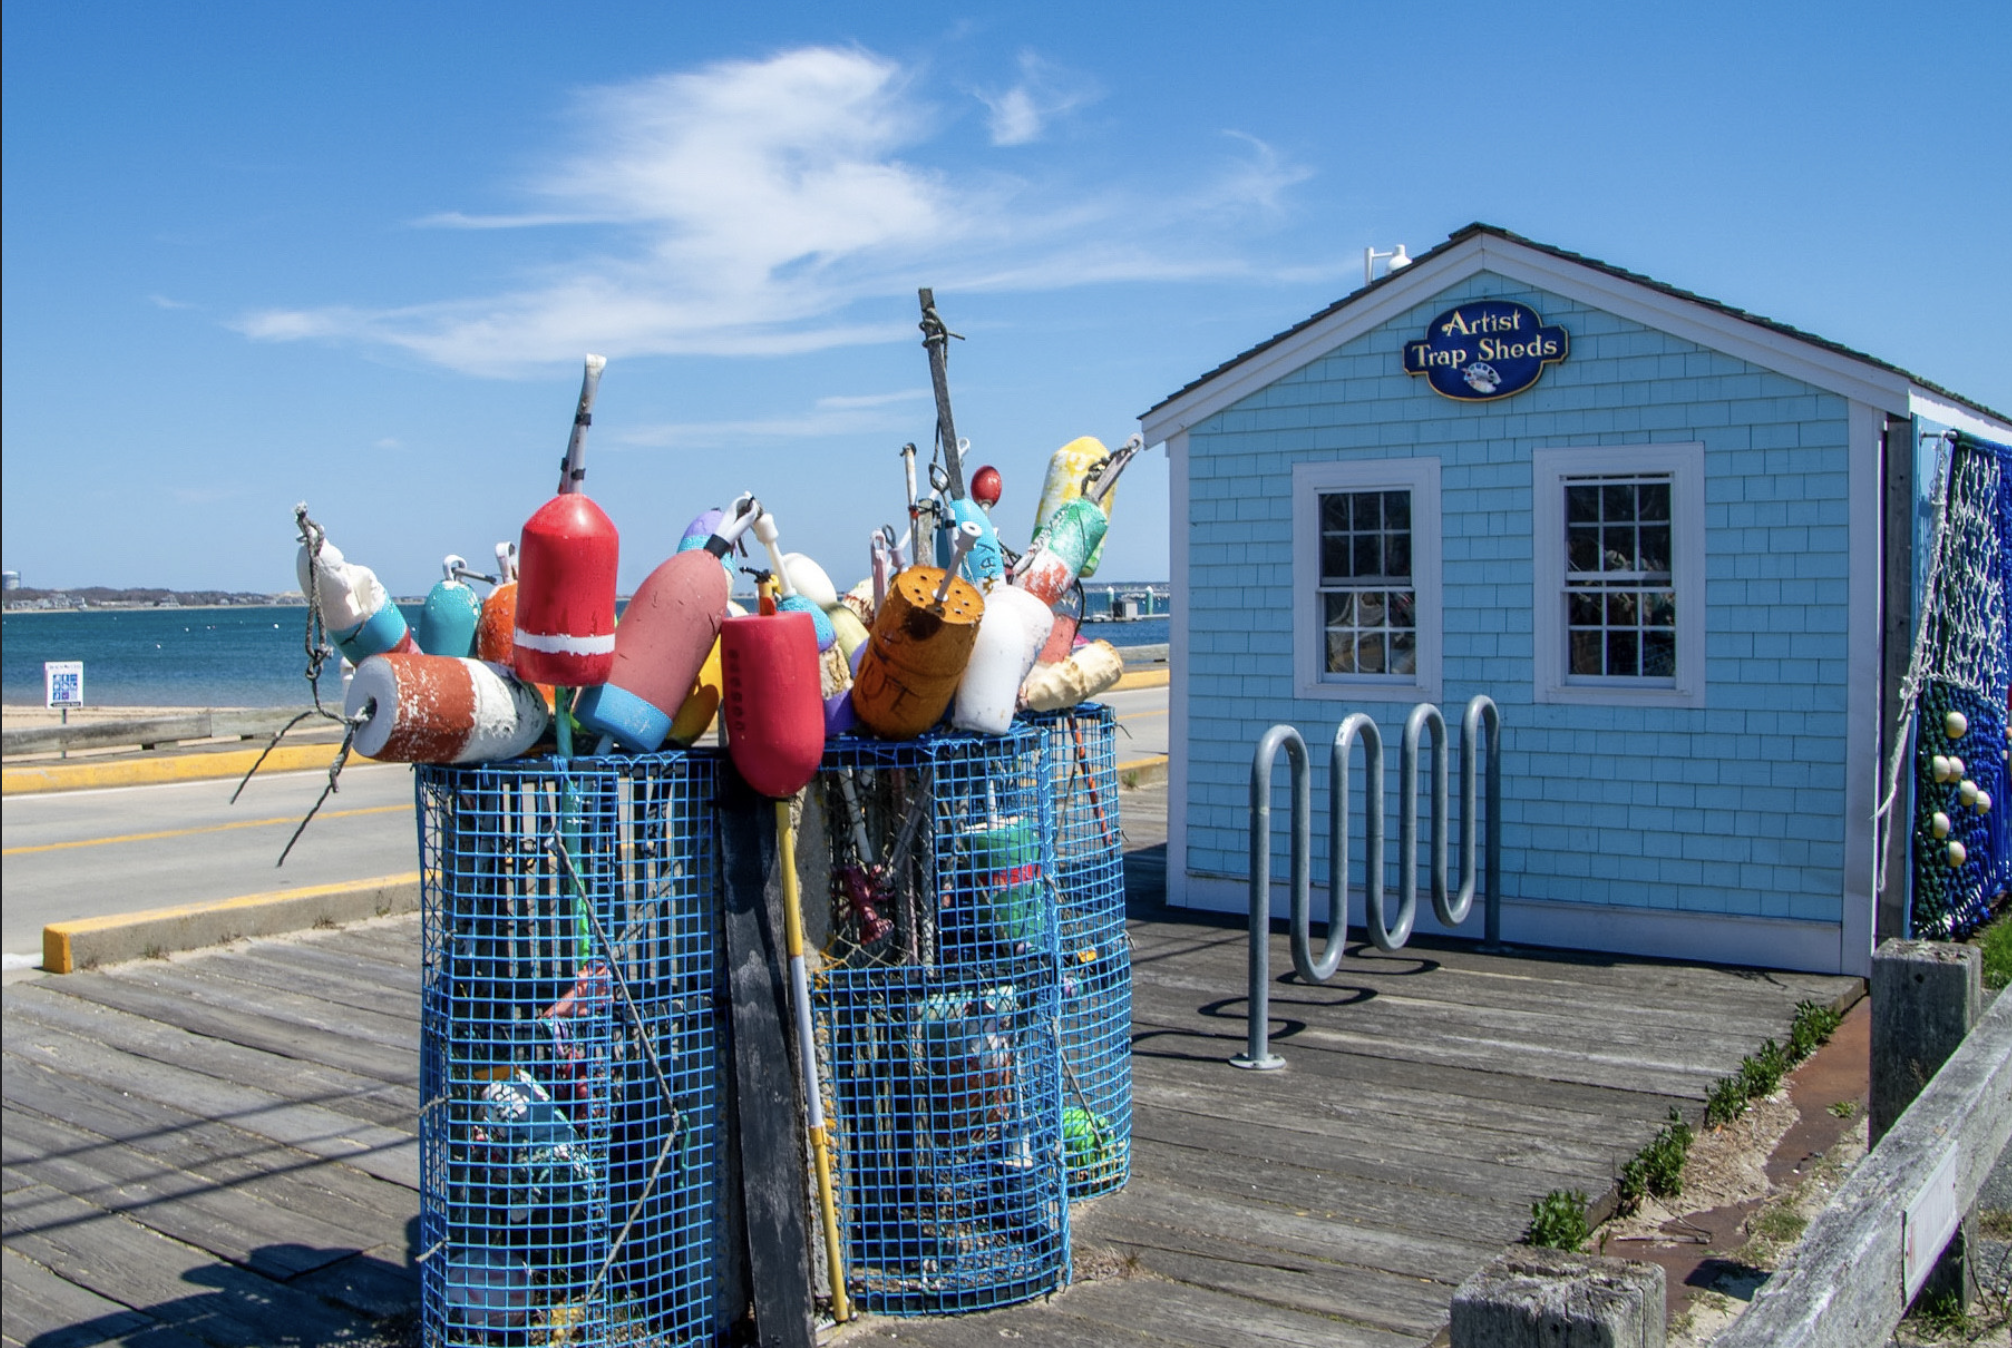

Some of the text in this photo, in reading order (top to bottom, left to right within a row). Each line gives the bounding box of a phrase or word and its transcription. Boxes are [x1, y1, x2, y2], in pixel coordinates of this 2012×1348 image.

[1442, 309, 1521, 337] Artist
[1412, 334, 1558, 369] Trap Sheds
